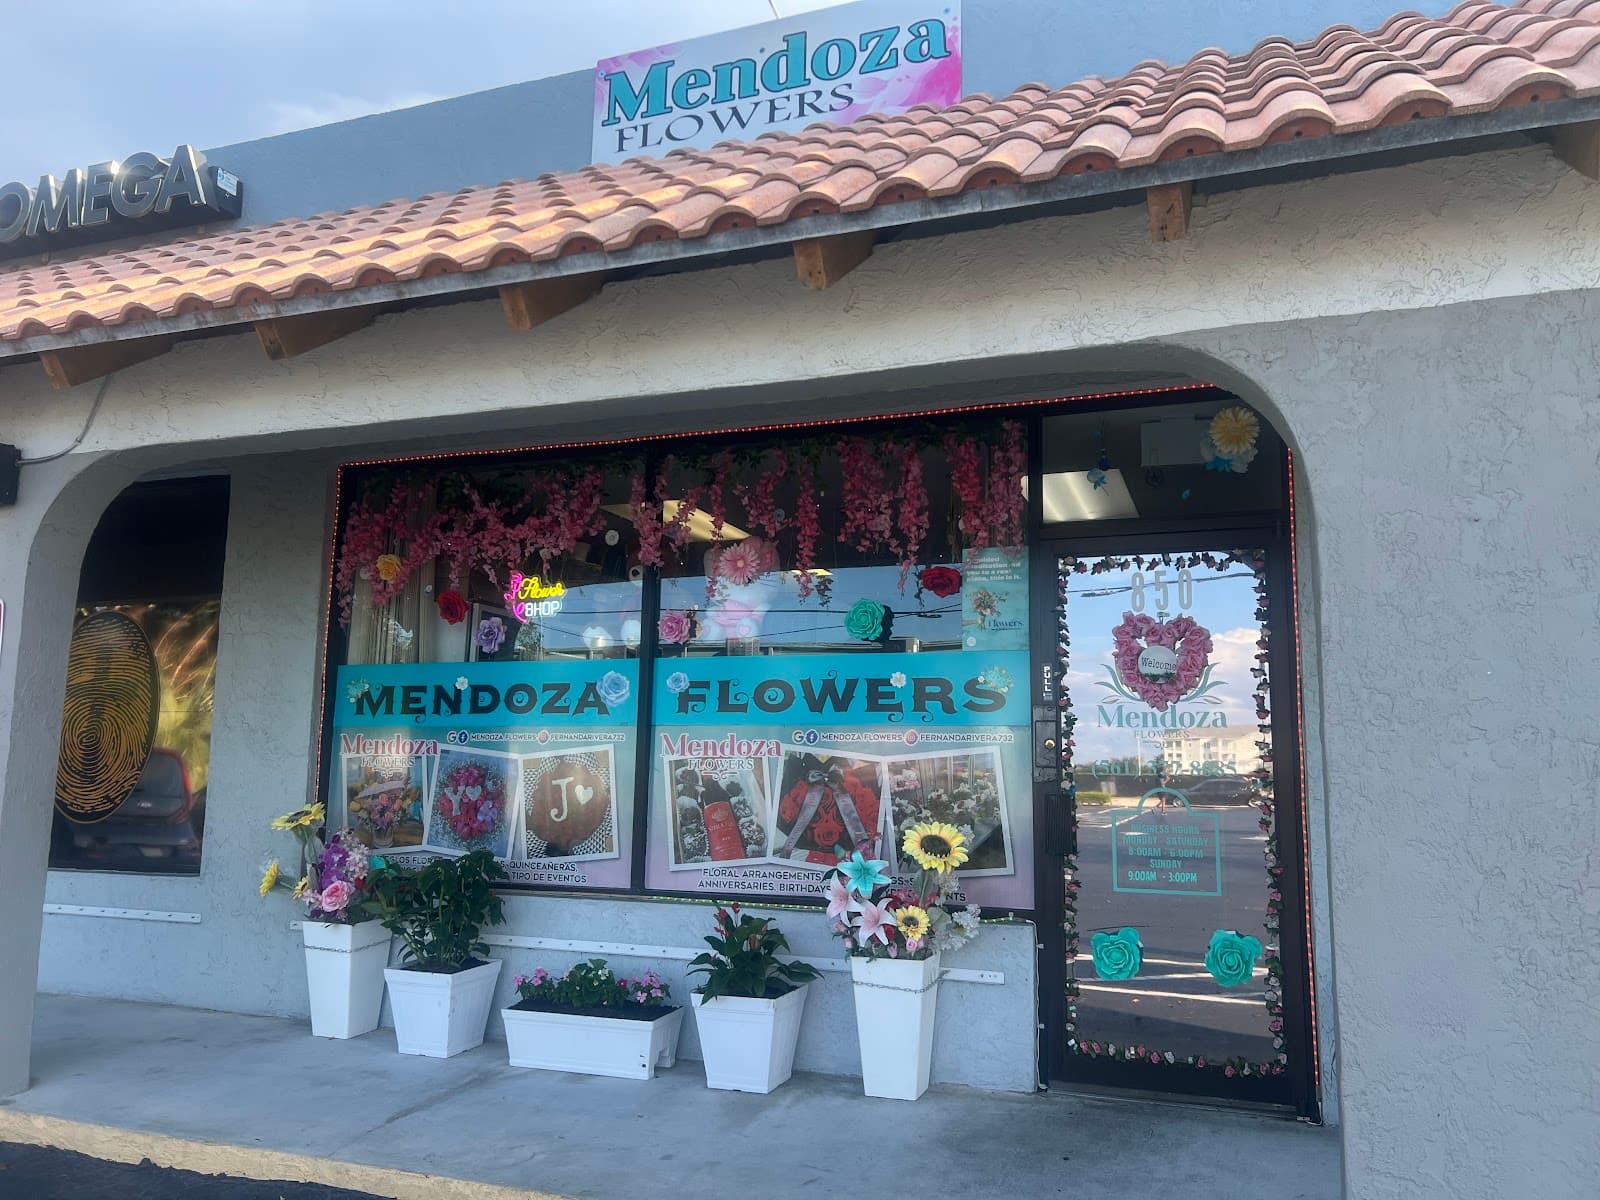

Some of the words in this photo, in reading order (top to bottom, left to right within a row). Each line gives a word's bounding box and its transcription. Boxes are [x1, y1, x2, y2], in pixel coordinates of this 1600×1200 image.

[601, 18, 951, 127] Mendoza
[616, 83, 855, 152] FLOWERS
[0, 144, 209, 243] OMEGA
[1131, 569, 1193, 612] 850
[525, 600, 560, 617] SHOP
[1141, 657, 1177, 671] Welcome
[1043, 665, 1051, 692] PULL
[353, 681, 610, 723] MENDOZA
[675, 670, 1008, 722] FLOWERS
[1096, 704, 1228, 728] Mendoza
[341, 734, 439, 755] Mendoza
[471, 733, 503, 741] MENDOZA
[662, 734, 782, 757] Mendoza
[822, 733, 861, 741] MENDOZA
[864, 733, 902, 741] FLOWERS
[361, 757, 416, 767] FLOWERS
[688, 759, 754, 770] FLOWERS
[702, 868, 739, 878] FLORAL
[1149, 859, 1182, 868] SUNDAY
[511, 871, 531, 881] TIPO
[533, 873, 545, 881] DE
[547, 873, 587, 883] EVENTOS
[1168, 872, 1198, 882] 3:00PM
